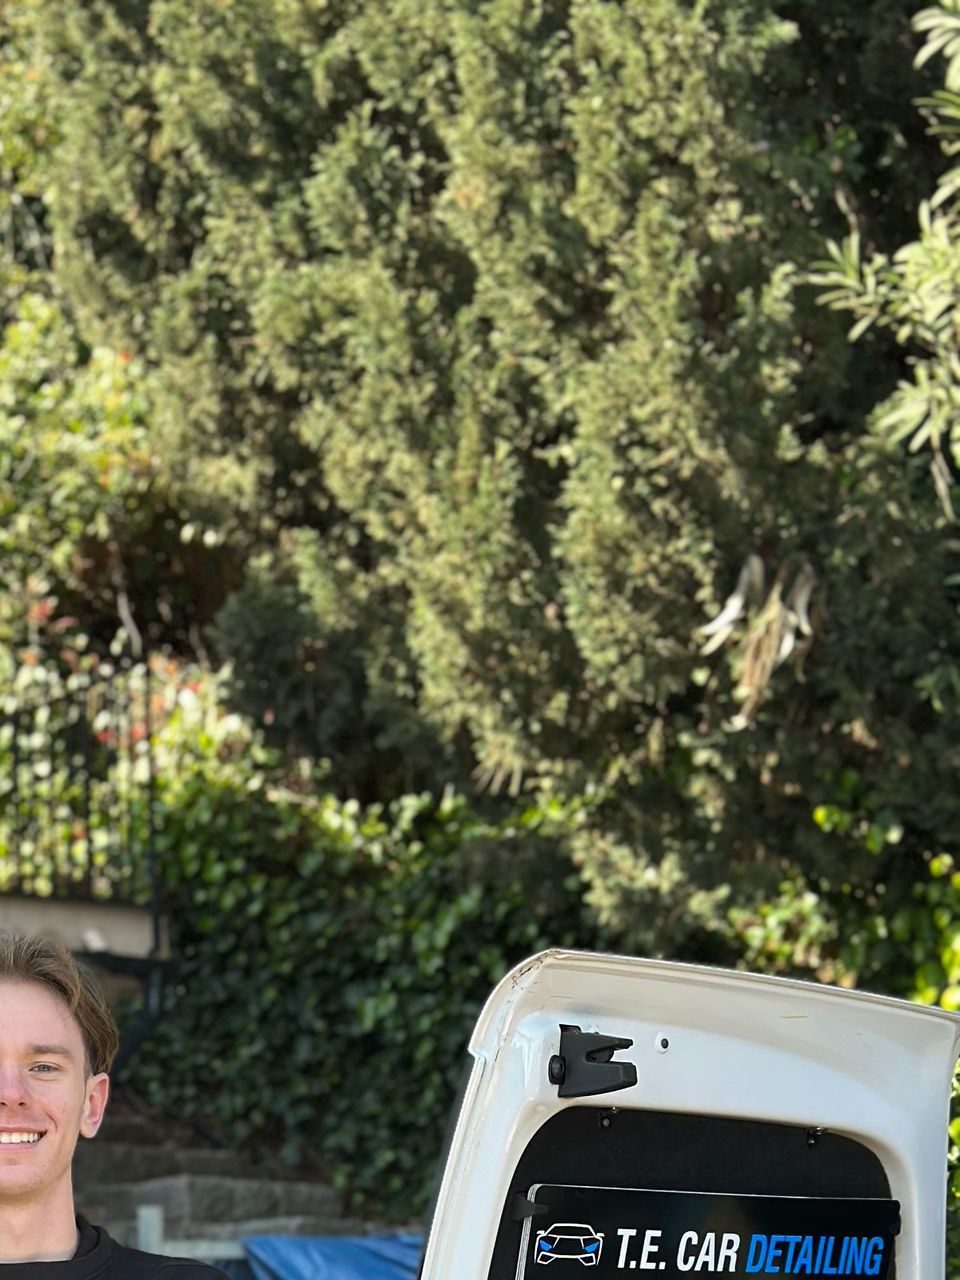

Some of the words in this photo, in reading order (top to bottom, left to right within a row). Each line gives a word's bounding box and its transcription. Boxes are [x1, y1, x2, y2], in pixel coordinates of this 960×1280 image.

[617, 1228, 666, 1270] T.E.
[676, 1230, 740, 1272] CAR
[745, 1234, 884, 1275] DETAILING
